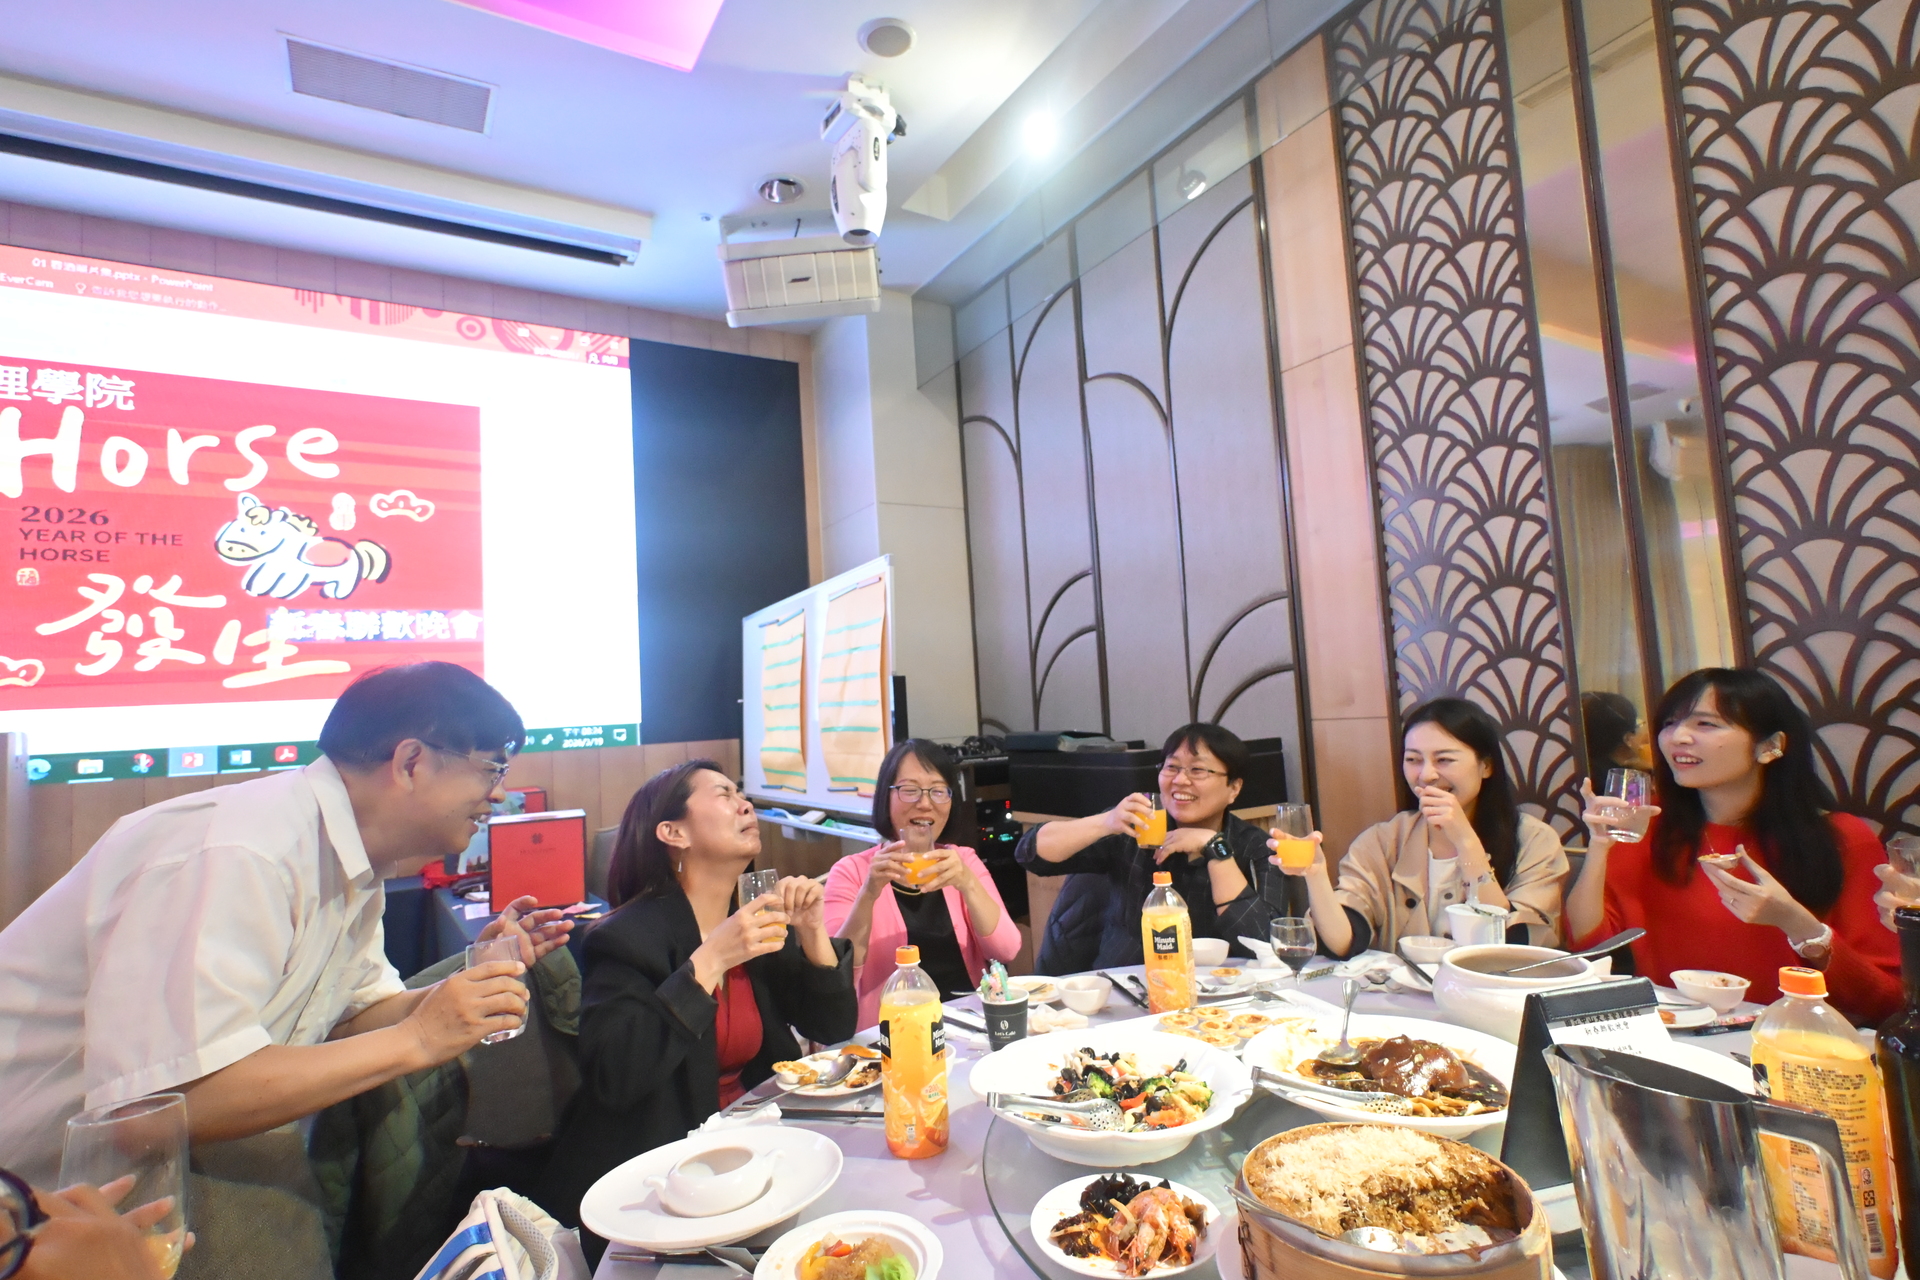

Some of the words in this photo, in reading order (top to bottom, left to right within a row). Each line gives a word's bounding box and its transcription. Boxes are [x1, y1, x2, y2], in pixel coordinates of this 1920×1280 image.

[151, 274, 214, 292] PowerPoint
[0, 405, 341, 499] Horse
[21, 505, 109, 526] 2026
[19, 527, 86, 543] YEAR
[94, 530, 128, 544] OF
[135, 532, 184, 547] THE
[20, 547, 110, 563] HORSE
[1154, 936, 1176, 944] Minute
[1156, 943, 1173, 951] Maid
